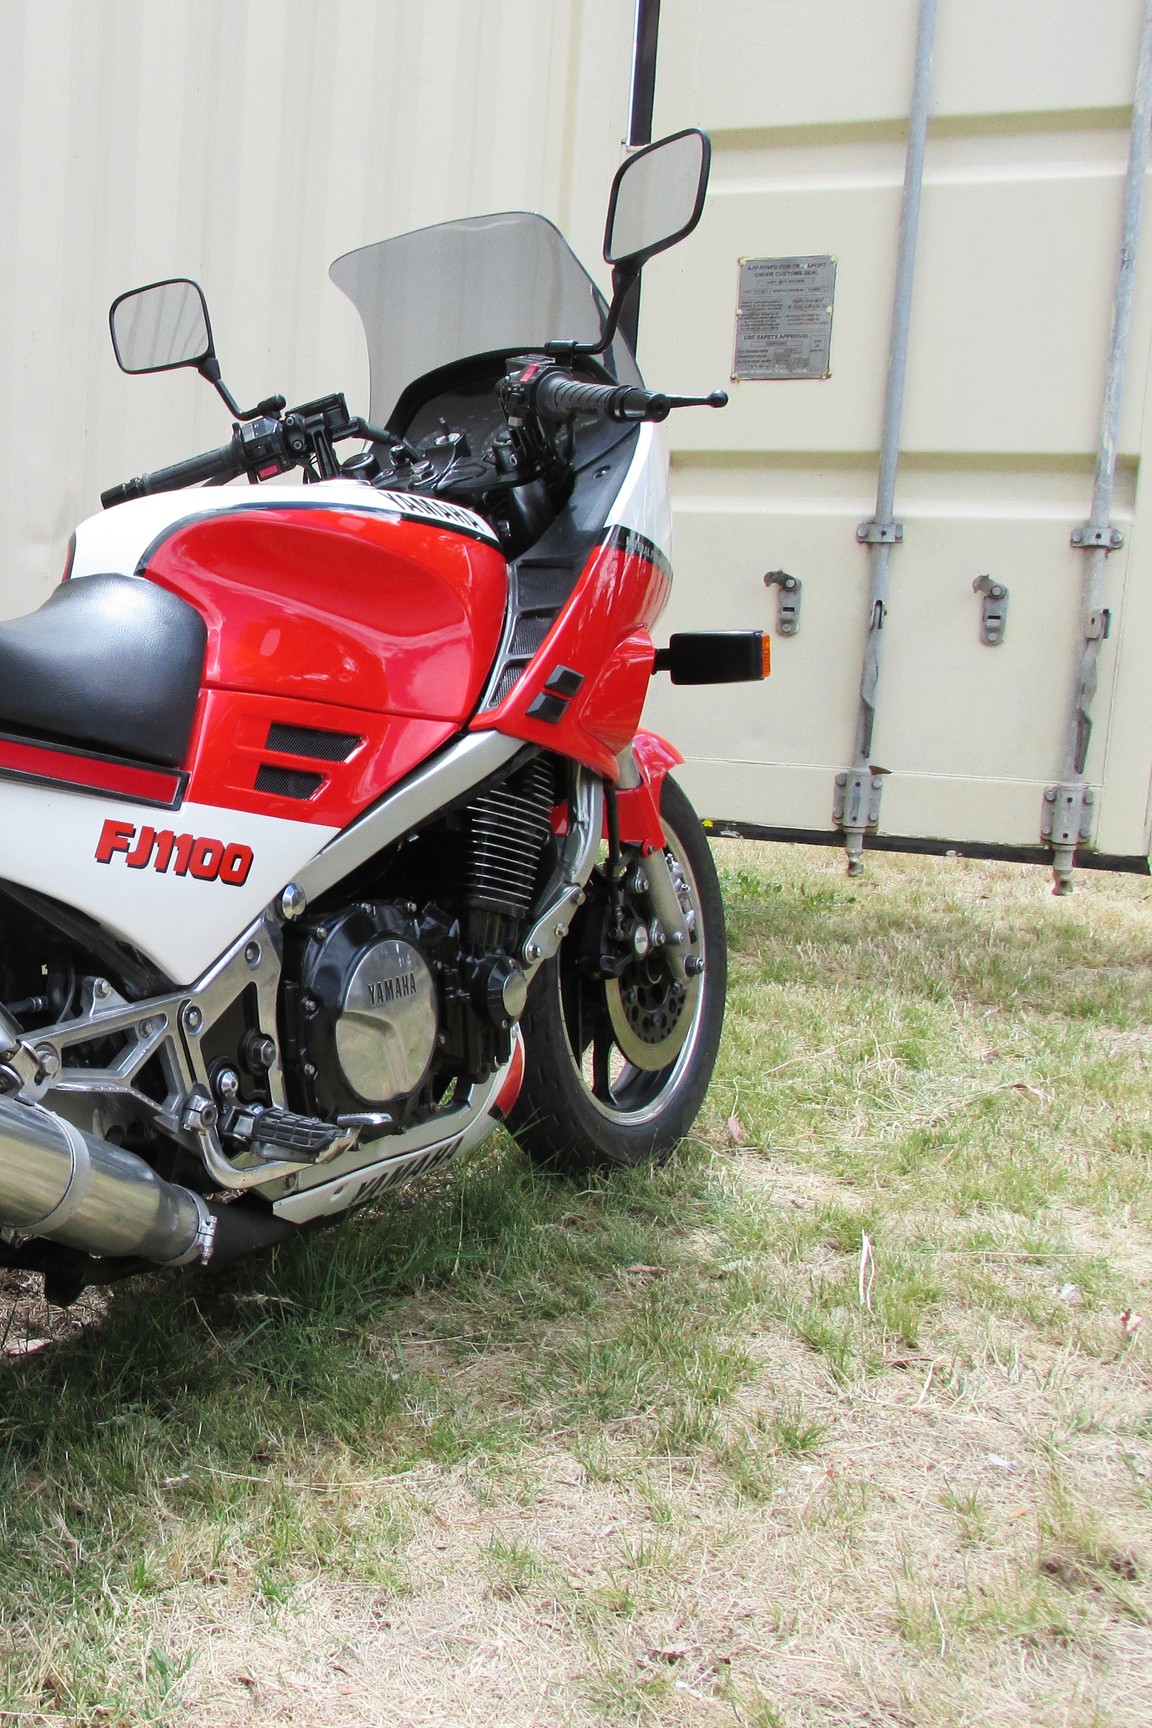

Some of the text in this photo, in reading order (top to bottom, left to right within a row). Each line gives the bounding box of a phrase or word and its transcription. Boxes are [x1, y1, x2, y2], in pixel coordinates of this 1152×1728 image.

[377, 491, 485, 532] YAMAHA
[94, 818, 254, 887] FJ1100
[368, 972, 417, 1005] YAMAHA
[350, 1136, 464, 1203] YAMAHA
